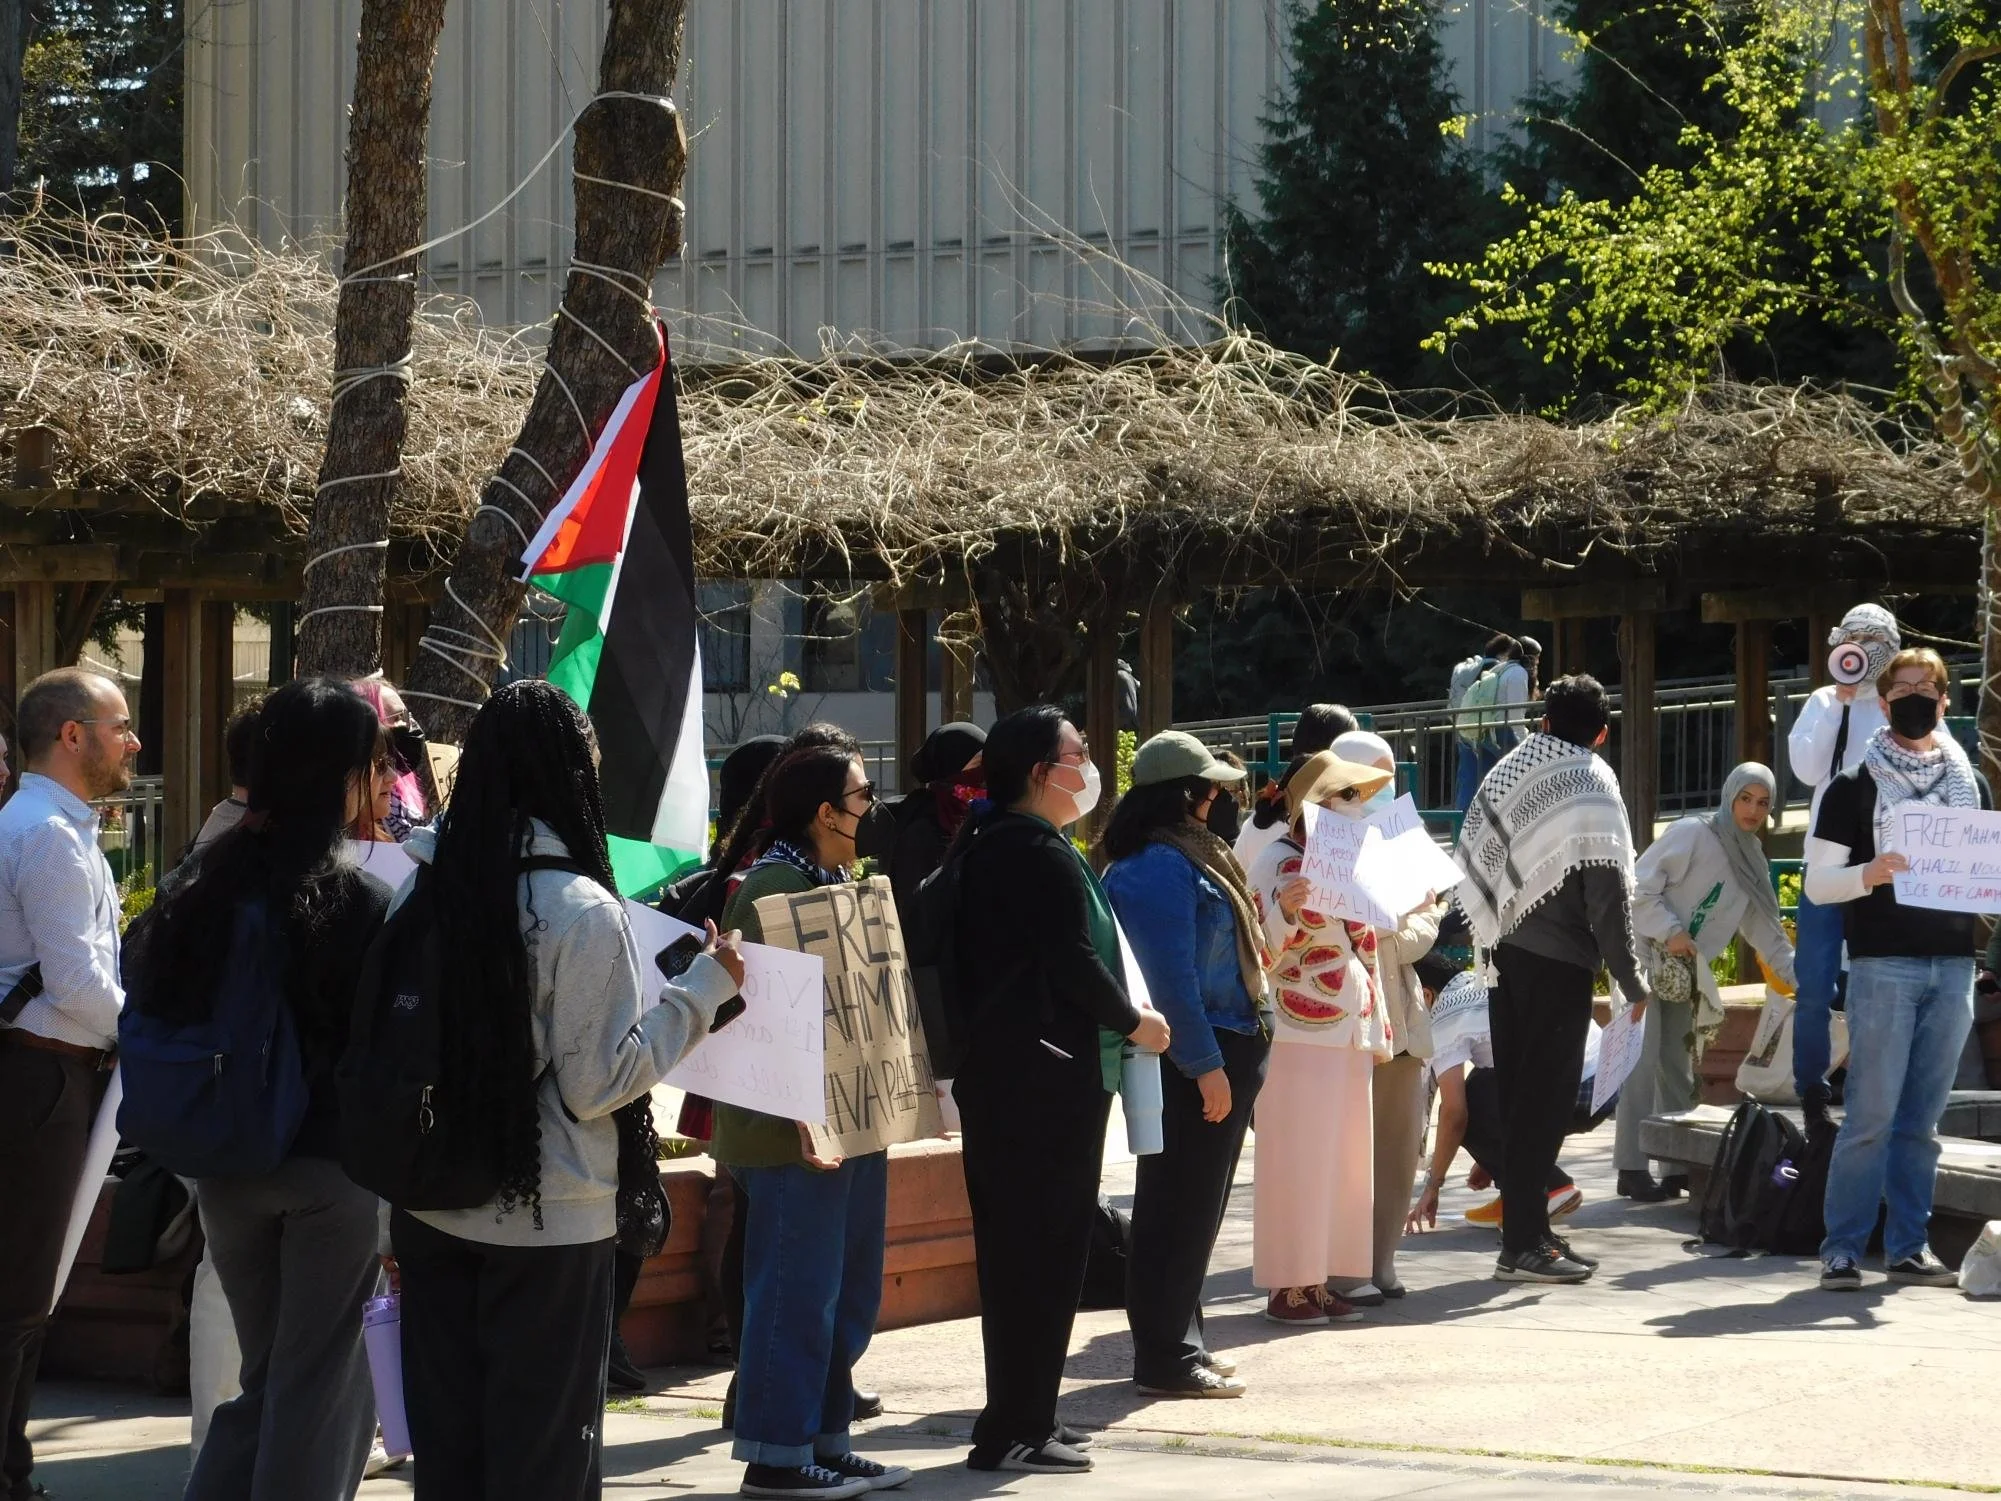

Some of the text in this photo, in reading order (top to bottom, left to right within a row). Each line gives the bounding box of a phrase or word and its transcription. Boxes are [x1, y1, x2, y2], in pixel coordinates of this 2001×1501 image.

[1903, 813, 2001, 848] FREE MAHM
[1305, 856, 1362, 884] MAHM
[1908, 854, 1964, 876] KHALIL
[1901, 881, 2001, 902] ICE OFF CAMP
[788, 885, 902, 971] FREE
[671, 950, 696, 970] 12:20
[823, 965, 921, 1050] AHMOUD
[822, 1062, 890, 1143] IVA
